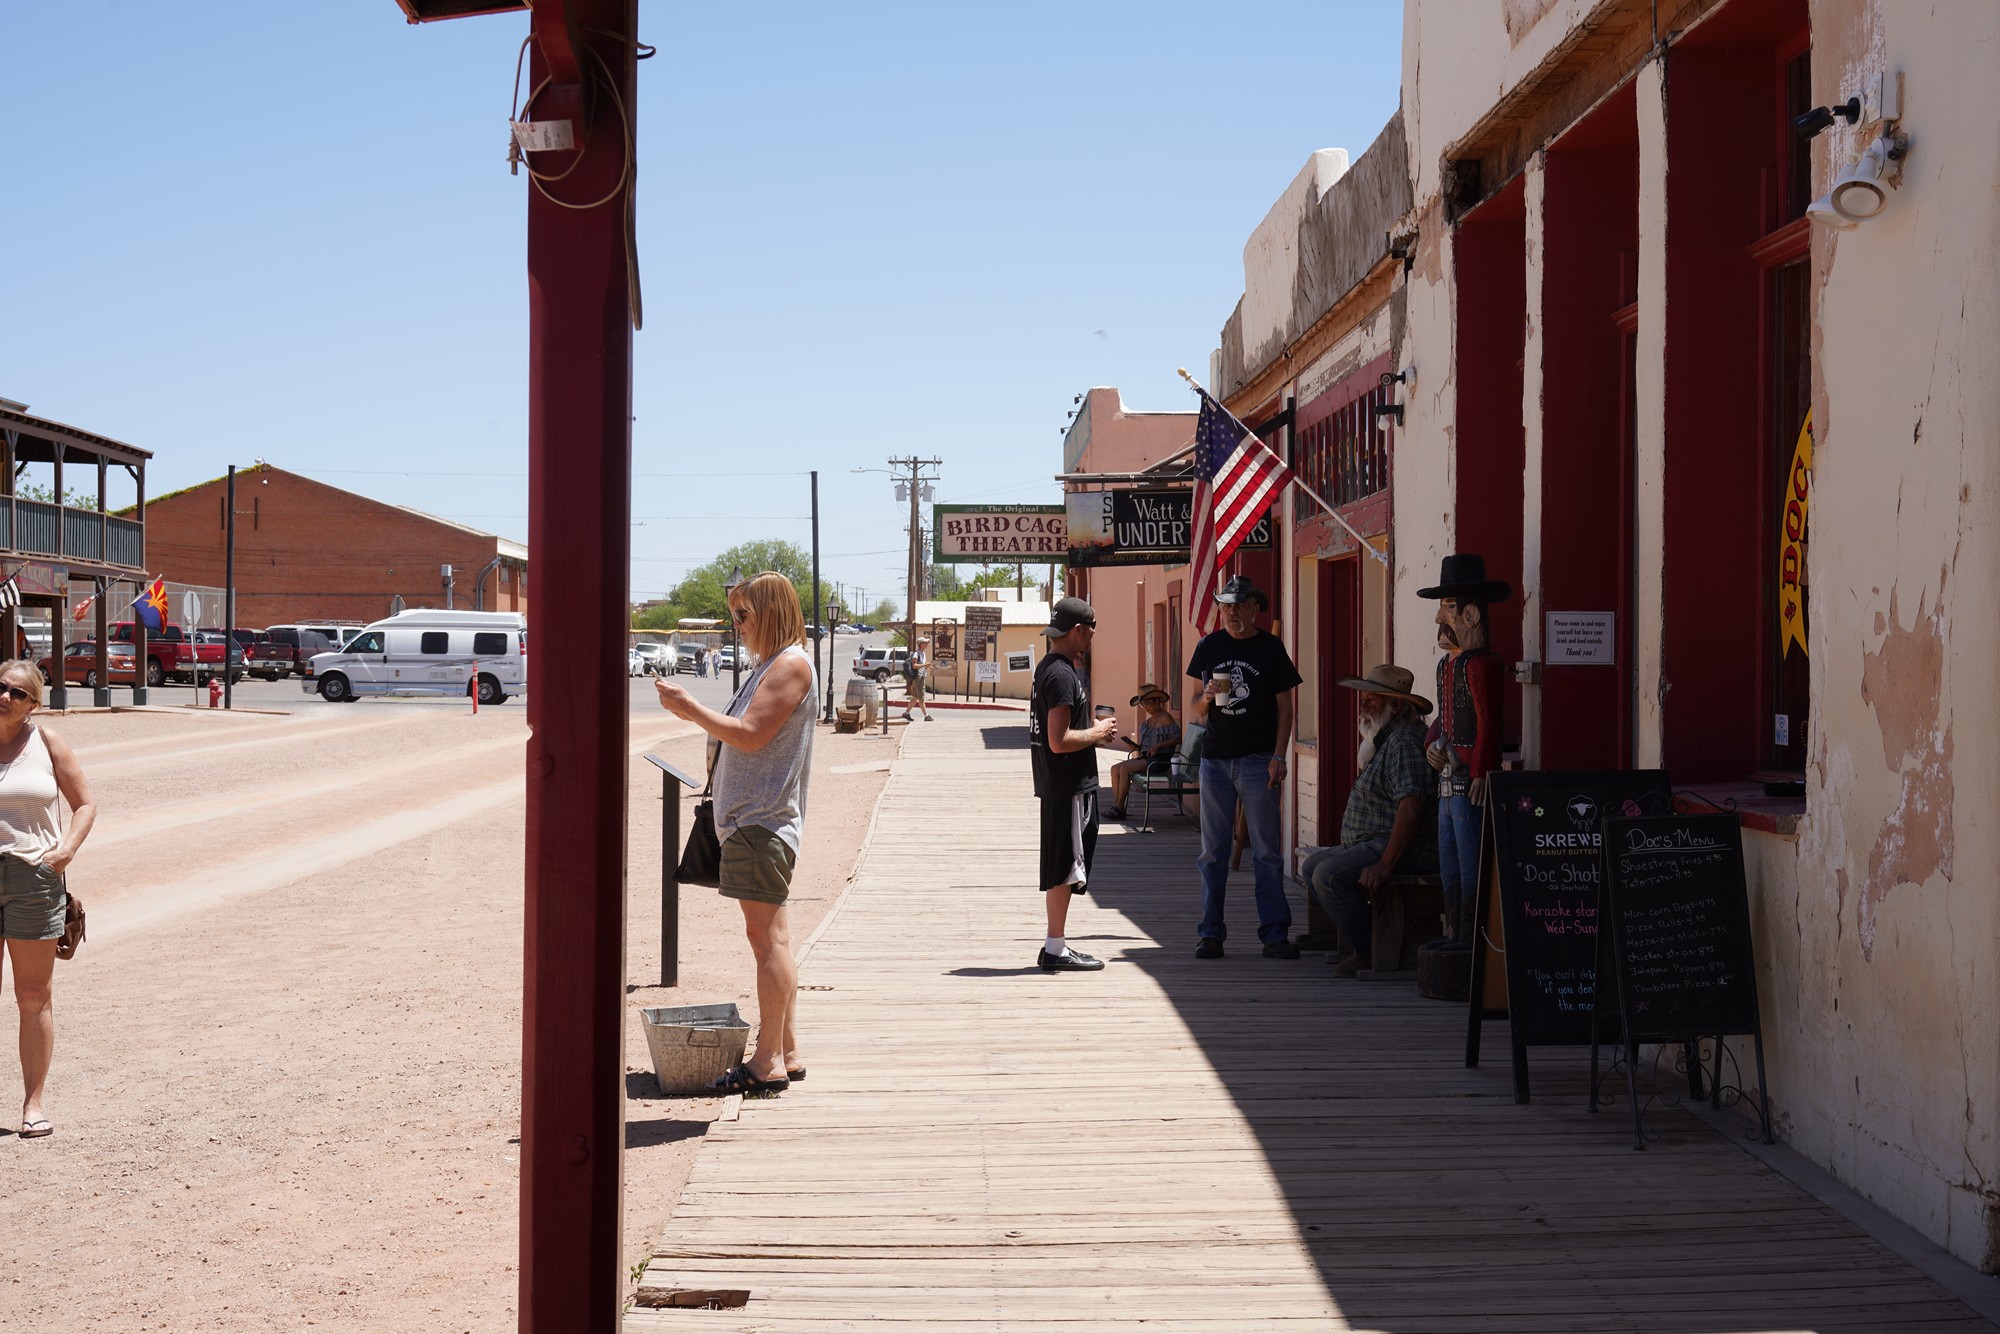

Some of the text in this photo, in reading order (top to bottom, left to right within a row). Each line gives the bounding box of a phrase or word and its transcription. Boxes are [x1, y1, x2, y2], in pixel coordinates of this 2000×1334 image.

[986, 505, 1040, 514] The Original
[1133, 498, 1192, 521] Watt &
[946, 516, 1068, 536] BIRD CAG
[956, 536, 1068, 552] THEATRE
[997, 556, 1041, 564] Tombstone
[1594, 620, 1606, 629] enjoy
[1565, 648, 1582, 656] Thank
[1535, 833, 1602, 848] SKREWB
[1625, 828, 1673, 850] Doc's
[1560, 862, 1601, 883] Shot
[1620, 857, 1680, 874] Shoestring
[1680, 856, 1702, 866] Fries
[1523, 900, 1573, 917] Karaoke
[1544, 981, 1553, 994] if
[1557, 986, 1575, 999] you
[1557, 999, 1576, 1011] the
